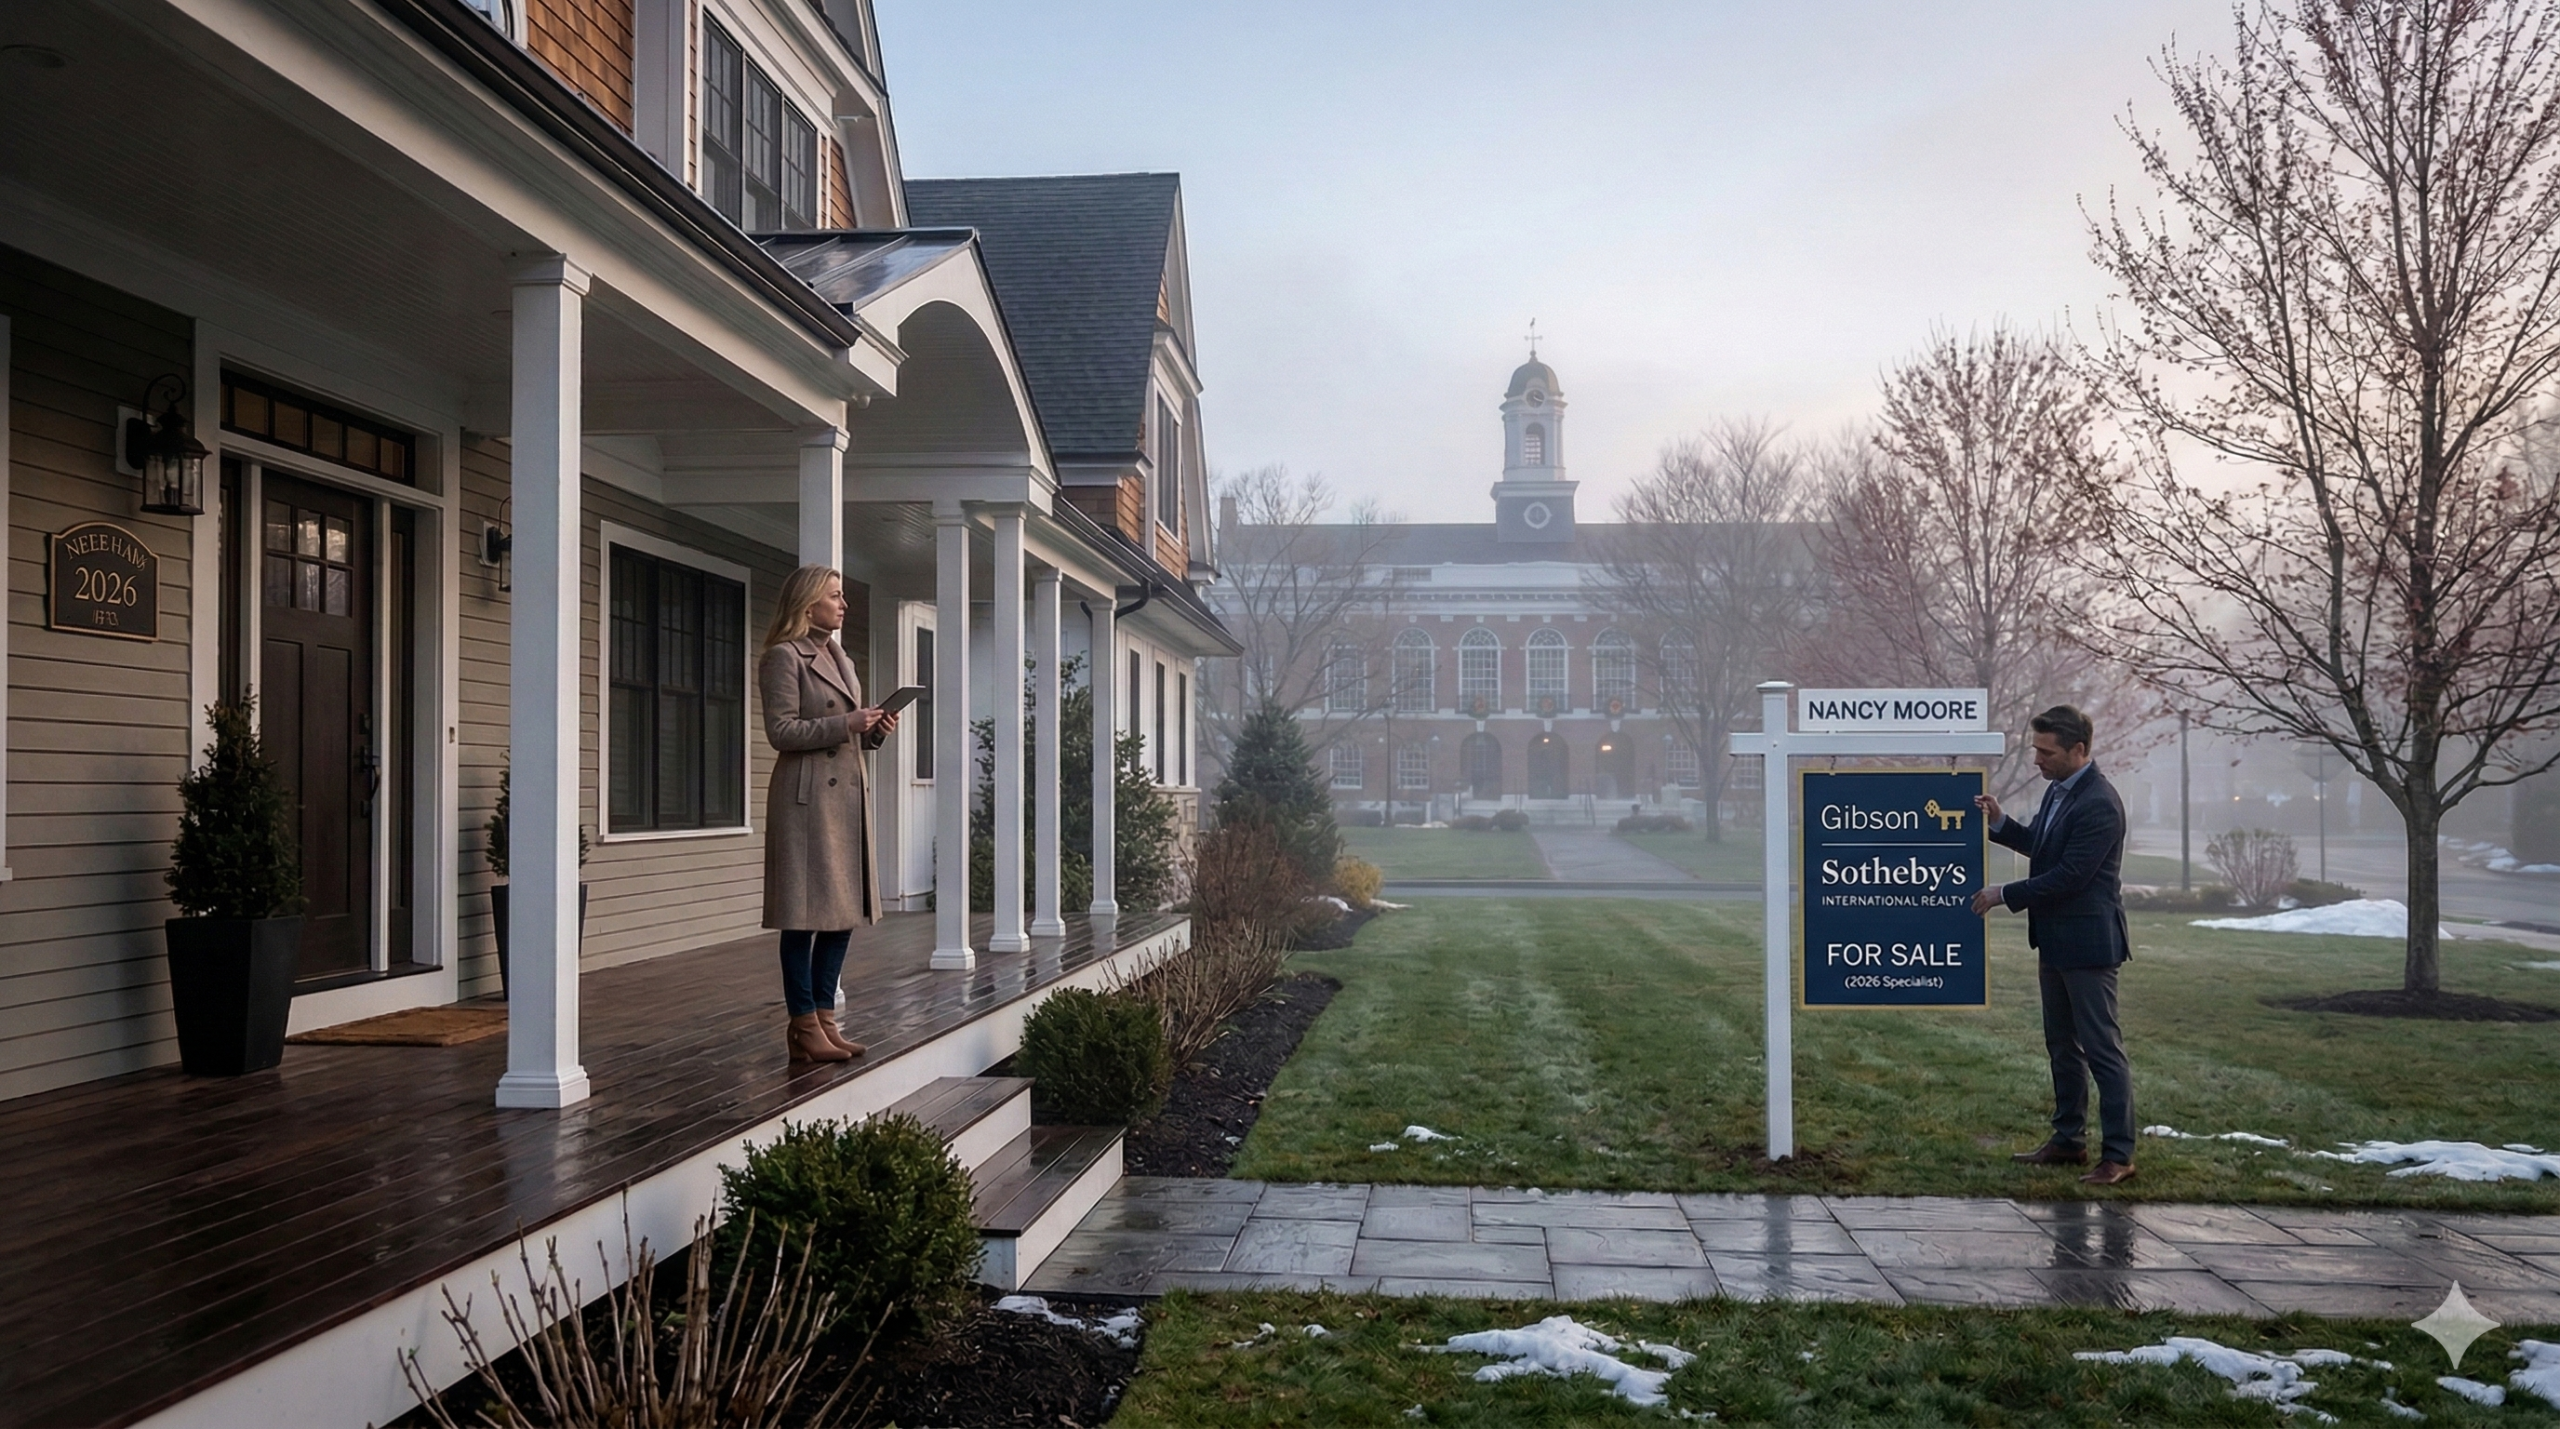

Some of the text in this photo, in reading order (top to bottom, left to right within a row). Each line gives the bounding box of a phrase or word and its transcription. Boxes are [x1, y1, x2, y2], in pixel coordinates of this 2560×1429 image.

[75, 566, 137, 607] 2026
[1809, 700, 1977, 720] NANCY MOORE
[1821, 804, 1918, 830] Gibson
[1822, 856, 1966, 891] Sotheby's
[1822, 895, 1965, 906] INTERNATIONAL REALTY
[1828, 943, 1962, 966] FOR SALE
[1845, 976, 1943, 989] (2026 Specialist)
